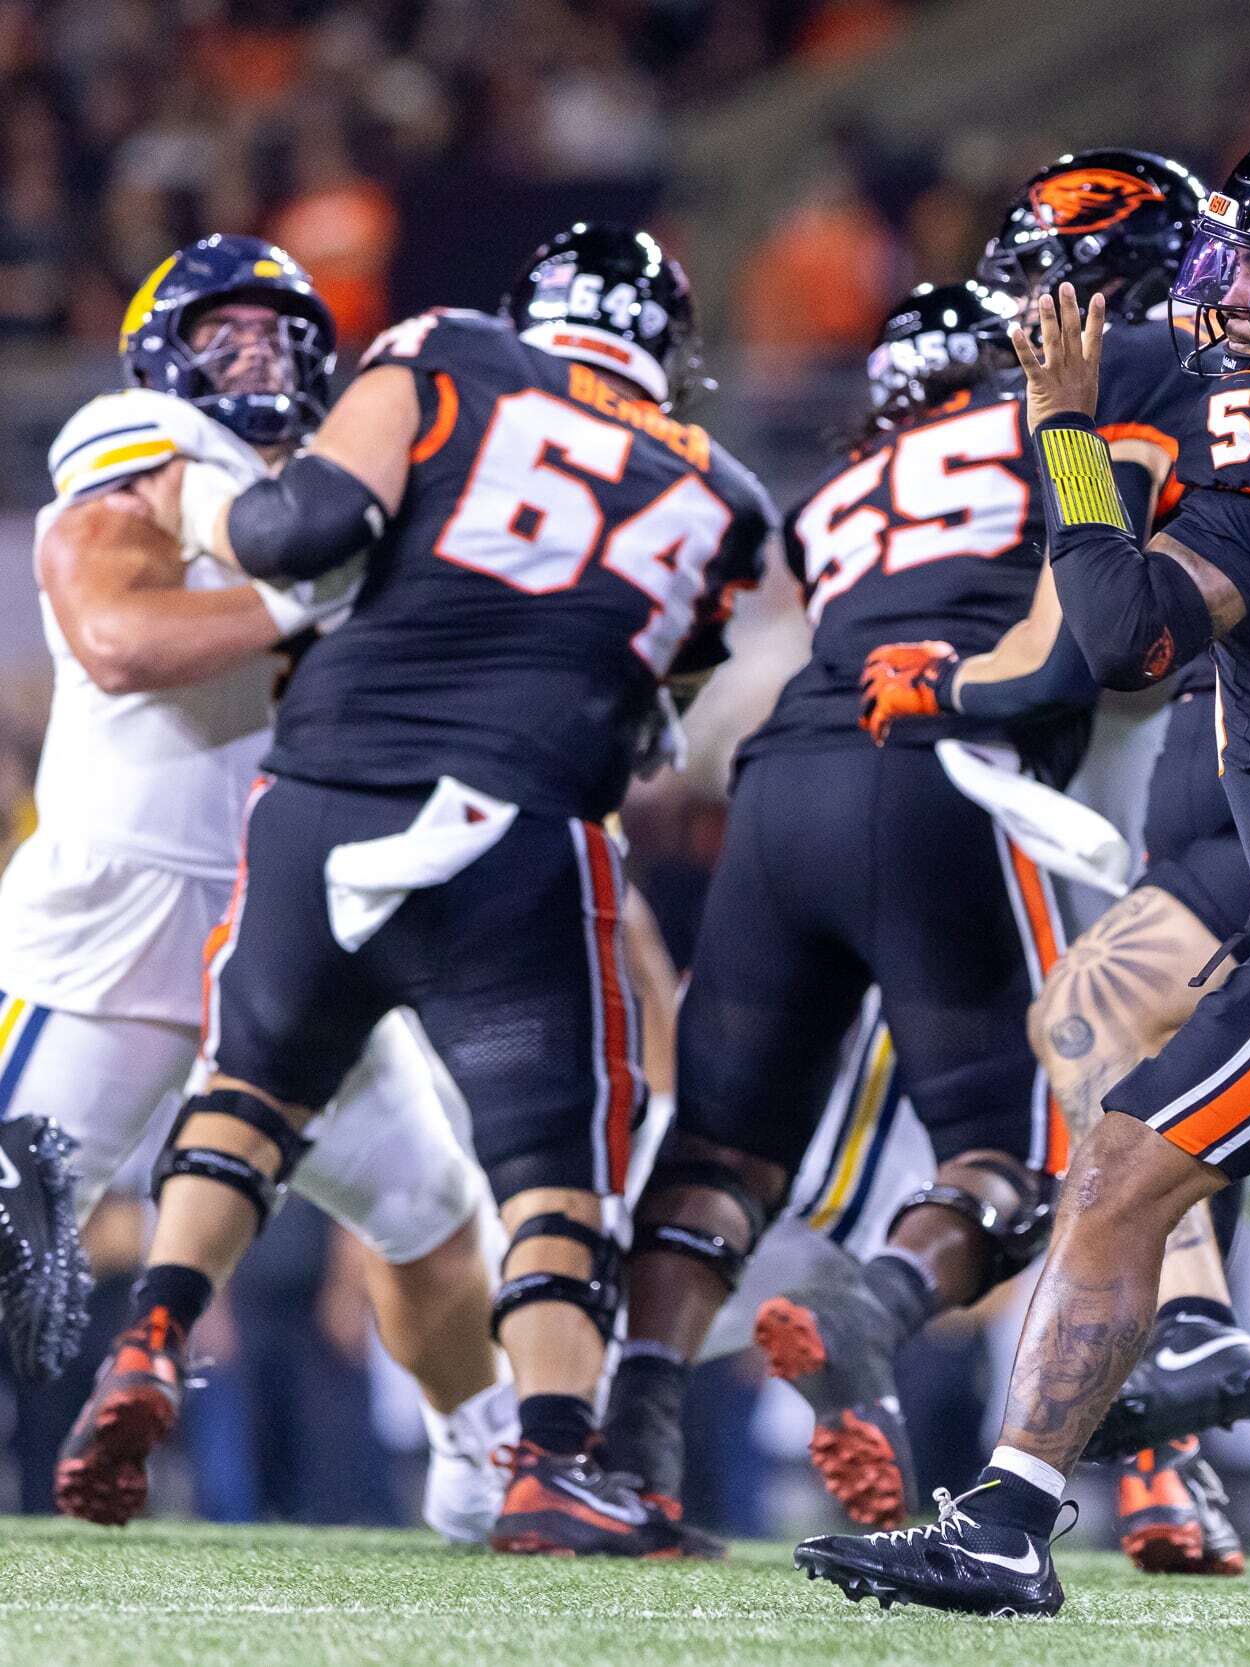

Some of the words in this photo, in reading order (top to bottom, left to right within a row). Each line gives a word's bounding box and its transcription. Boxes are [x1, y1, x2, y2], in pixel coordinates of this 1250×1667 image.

[569, 273, 638, 330] 64
[432, 387, 734, 682] 64
[795, 400, 1030, 627] 55
